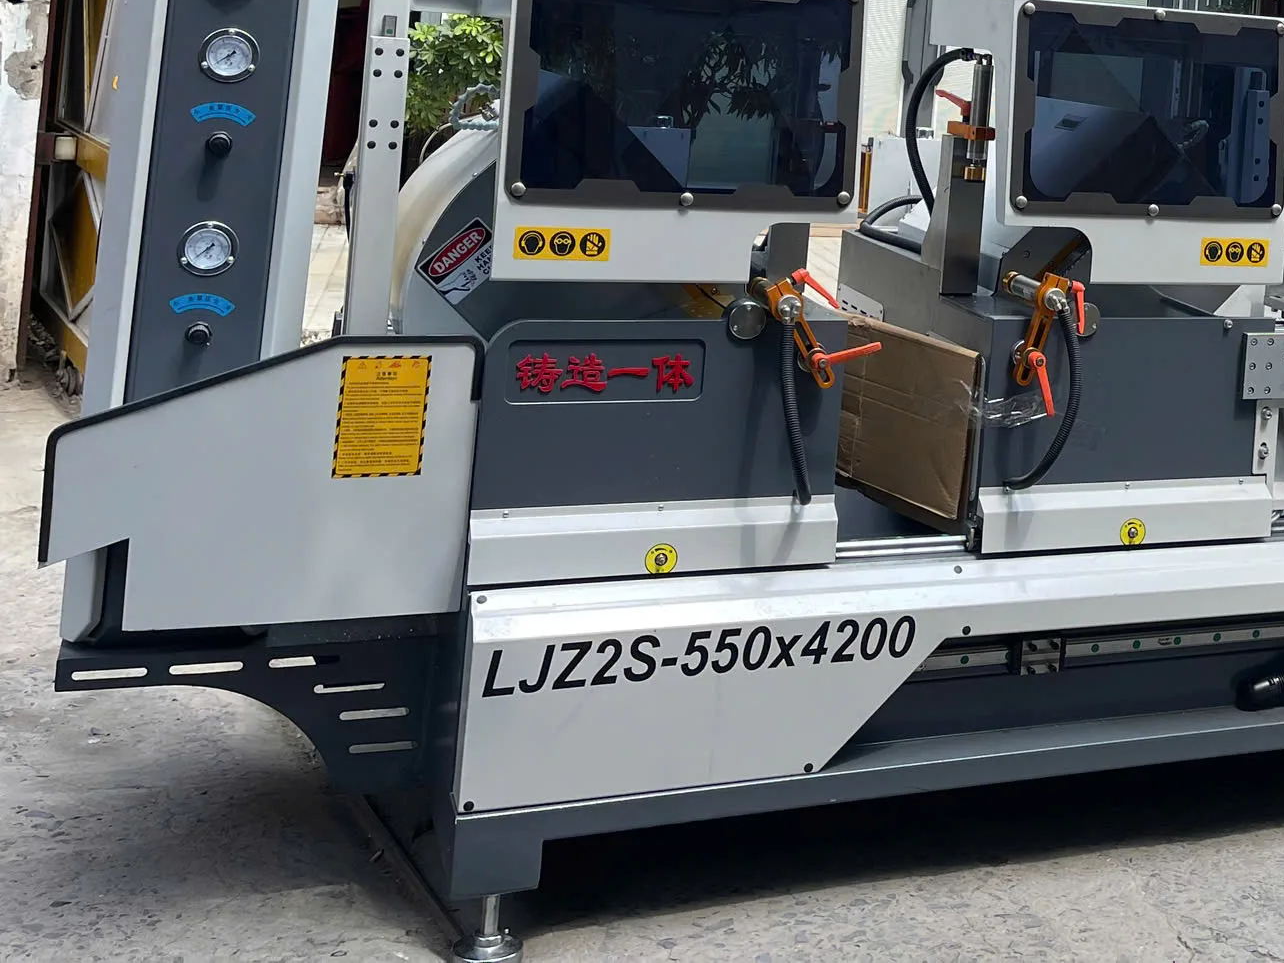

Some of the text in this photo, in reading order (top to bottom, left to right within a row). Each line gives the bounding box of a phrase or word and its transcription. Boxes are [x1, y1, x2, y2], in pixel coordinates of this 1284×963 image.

[433, 231, 482, 273] DANGER
[516, 352, 695, 393] 铸造一体
[482, 614, 917, 698] LJZ2S-550x4200
